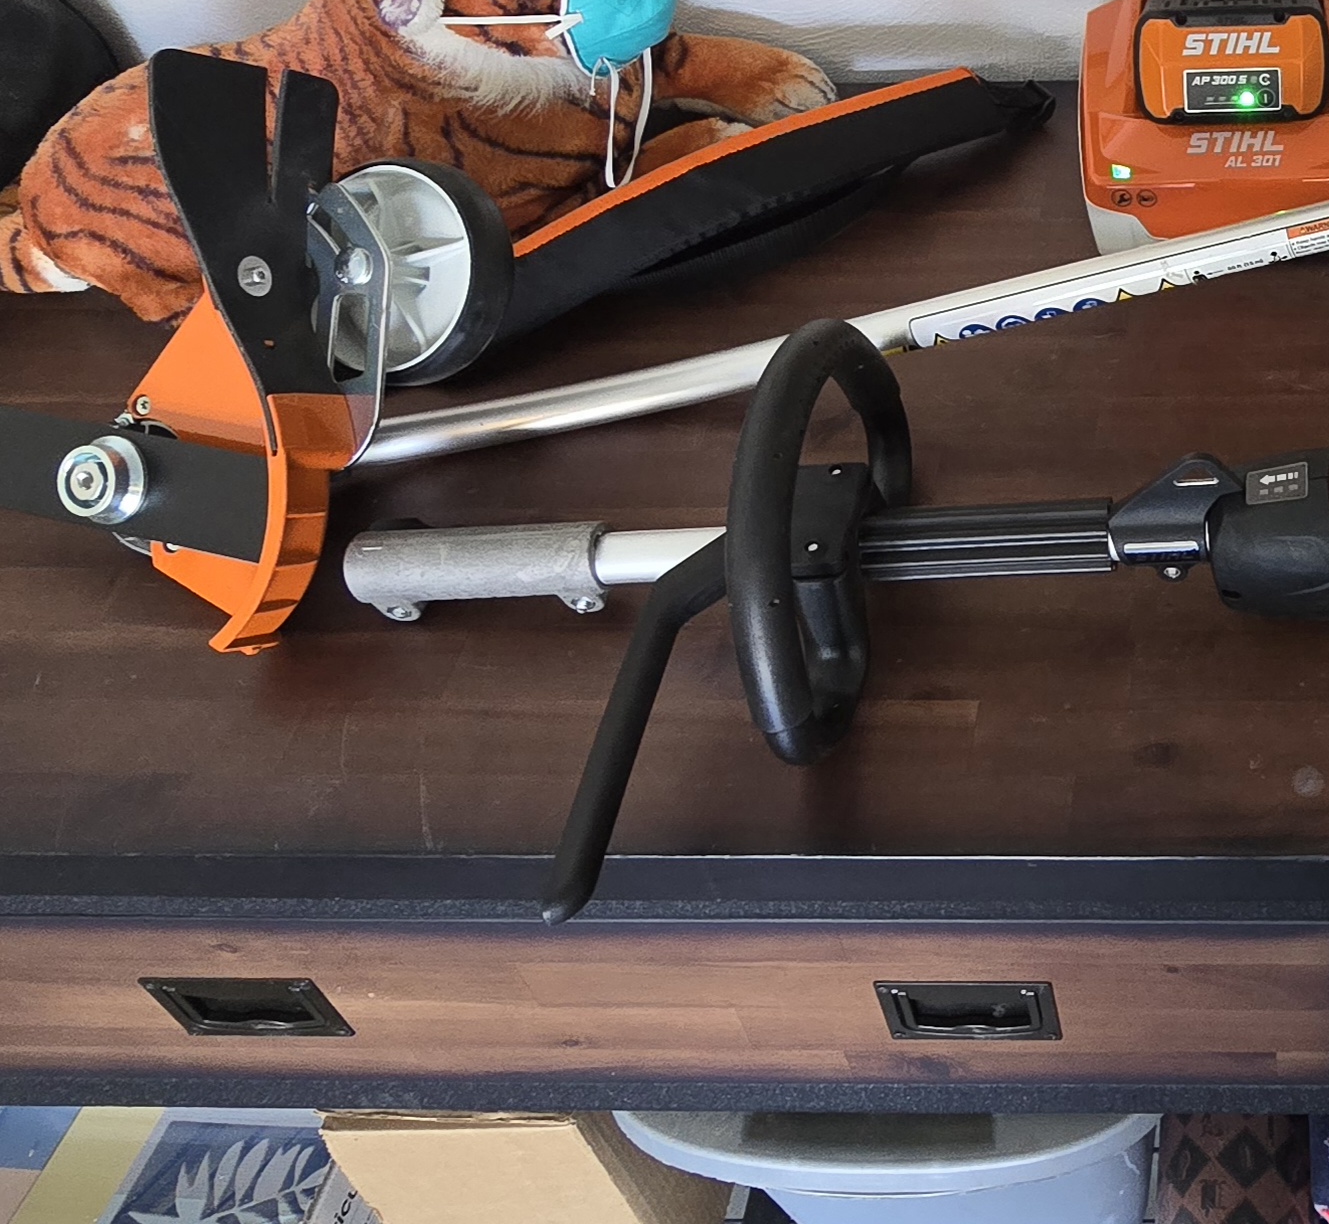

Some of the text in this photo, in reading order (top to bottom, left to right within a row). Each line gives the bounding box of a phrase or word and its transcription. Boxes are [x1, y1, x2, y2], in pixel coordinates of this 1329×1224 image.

[1182, 32, 1280, 56] STIHL
[1191, 75, 1210, 86] AP
[1211, 75, 1236, 85] 300
[1237, 75, 1248, 84] S
[1186, 130, 1284, 154] STIHL
[1224, 154, 1282, 167] AL 301
